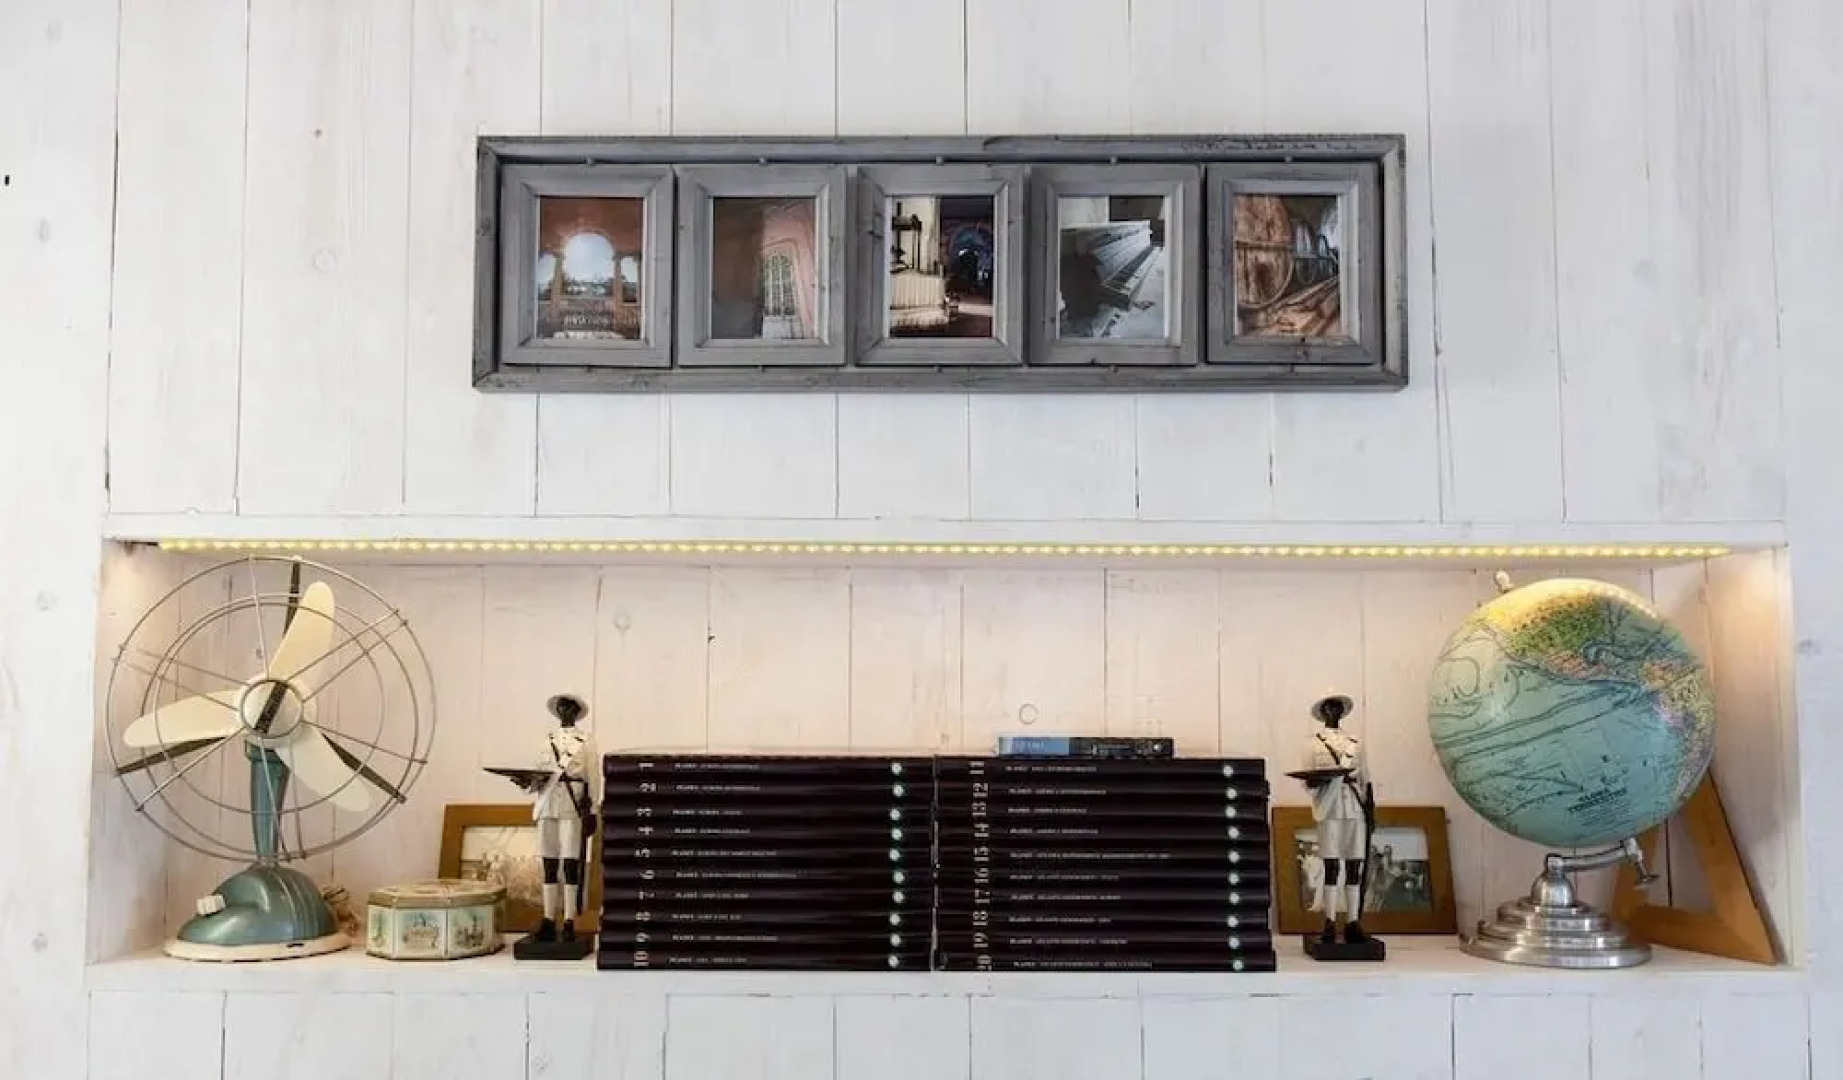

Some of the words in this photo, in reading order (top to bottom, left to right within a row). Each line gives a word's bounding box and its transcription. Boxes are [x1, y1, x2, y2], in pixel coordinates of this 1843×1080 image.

[969, 761, 984, 775] 11
[639, 783, 656, 792] 2
[973, 782, 988, 798] 12
[636, 808, 652, 817] 3
[972, 801, 987, 816] 13
[638, 827, 654, 835] 4
[974, 822, 989, 837] 14
[635, 848, 650, 857] 5
[974, 847, 989, 862] 15
[640, 869, 654, 879] 6
[974, 867, 989, 883] 16
[638, 891, 654, 900] 7
[974, 889, 990, 903] 17
[635, 911, 650, 921] 8
[972, 911, 988, 926] 18
[635, 932, 650, 942] 9
[972, 932, 989, 948] 19
[634, 950, 649, 967] 10
